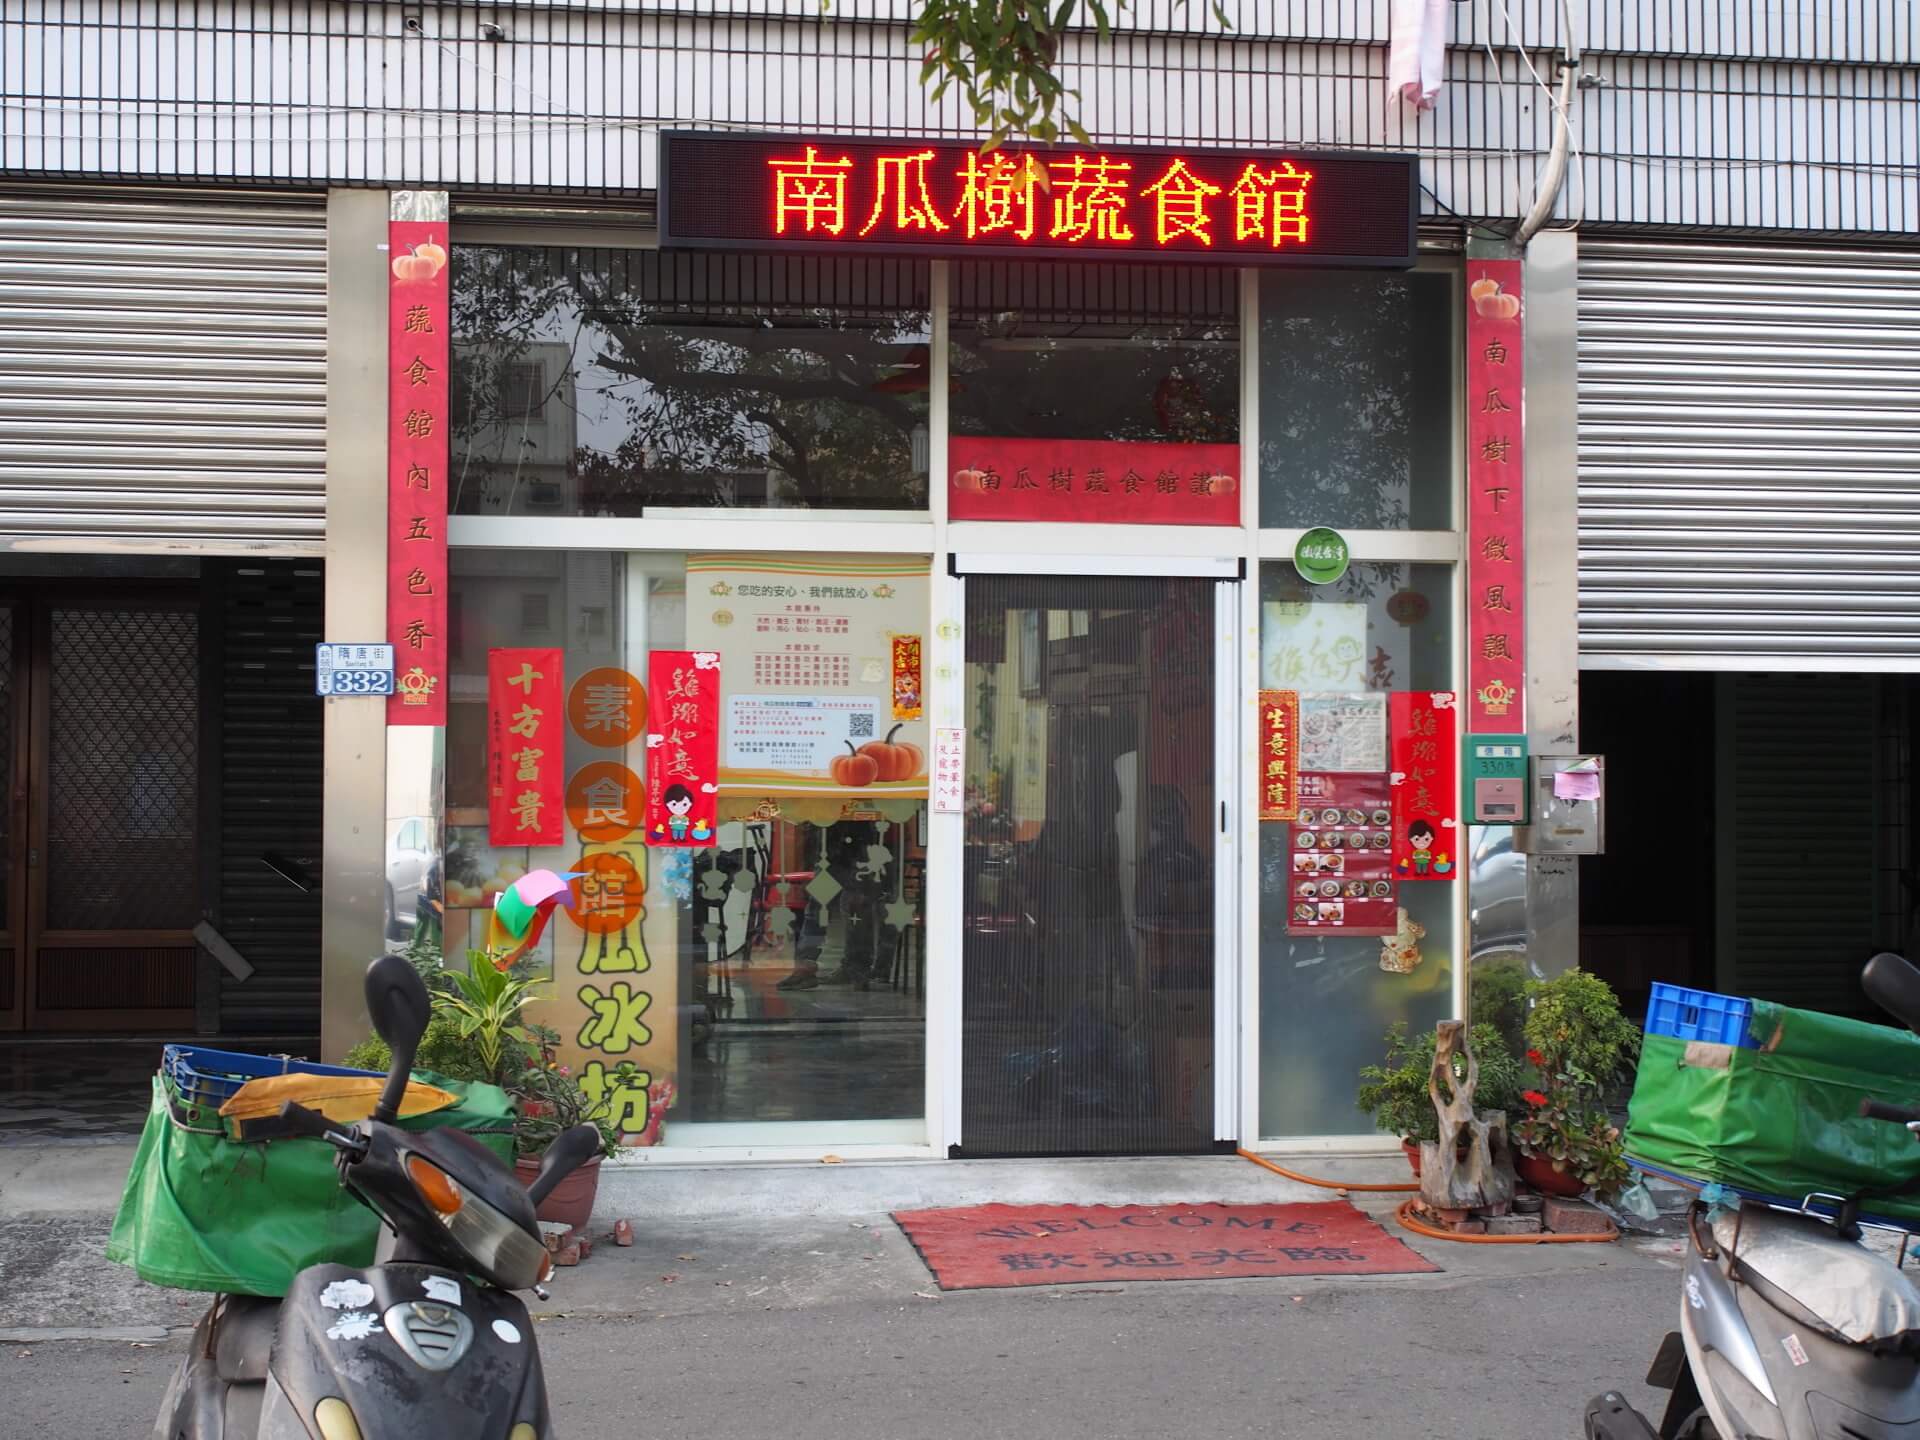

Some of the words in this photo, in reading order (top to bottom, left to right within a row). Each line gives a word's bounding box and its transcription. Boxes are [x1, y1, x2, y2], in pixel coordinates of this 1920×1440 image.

[767, 146, 1313, 247] 南瓜樹蔬食館
[403, 304, 436, 652] 蔬食館內五色香
[1481, 337, 1514, 662] 南瓜樹下微風飄
[335, 671, 388, 692] 332
[507, 663, 545, 833] 十方富貴
[1265, 708, 1289, 805] 生意興隆
[975, 1214, 1325, 1239] WELCOME
[998, 1247, 1367, 1272] 歡迎光臨
